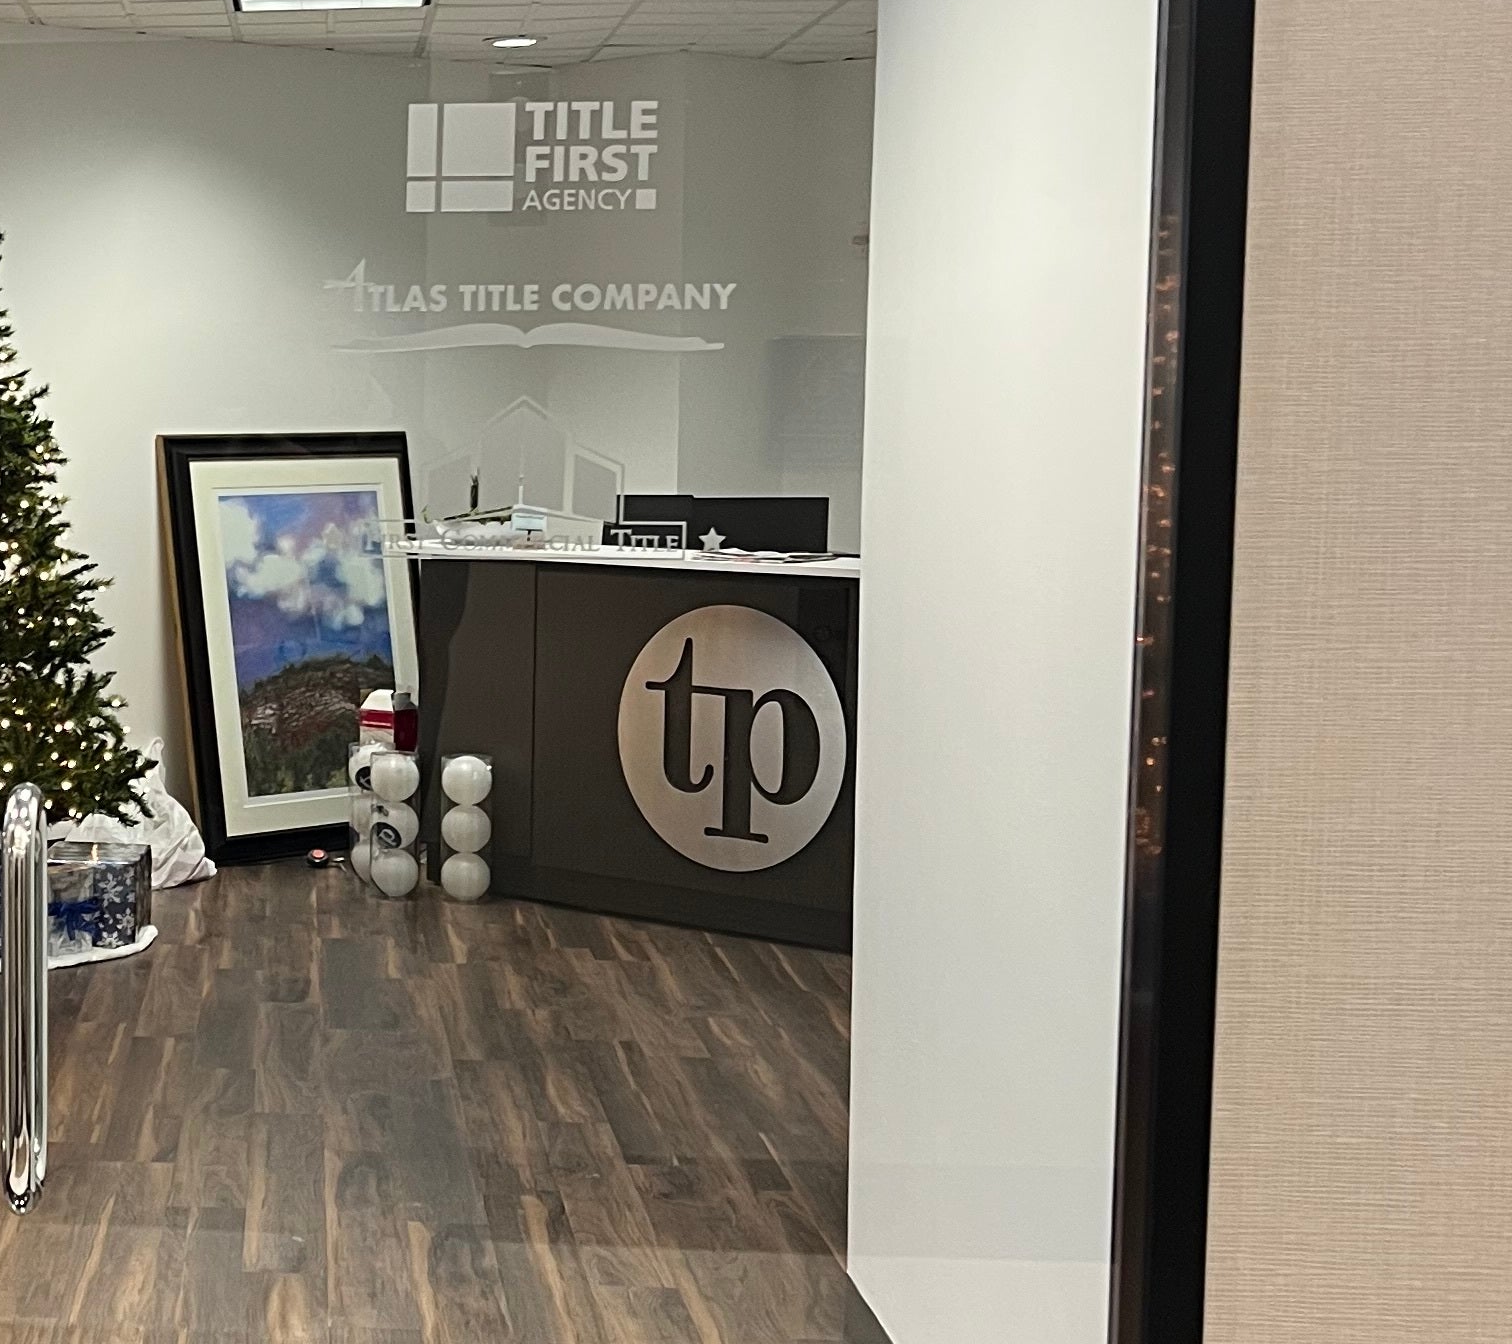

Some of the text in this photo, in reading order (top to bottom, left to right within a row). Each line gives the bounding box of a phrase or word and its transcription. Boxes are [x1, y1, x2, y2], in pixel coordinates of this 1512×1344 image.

[525, 100, 658, 140] TITLE
[525, 144, 658, 183] FIRST
[522, 188, 632, 211] AGENCY
[322, 257, 737, 313] ATLAS TITLE COMPANY
